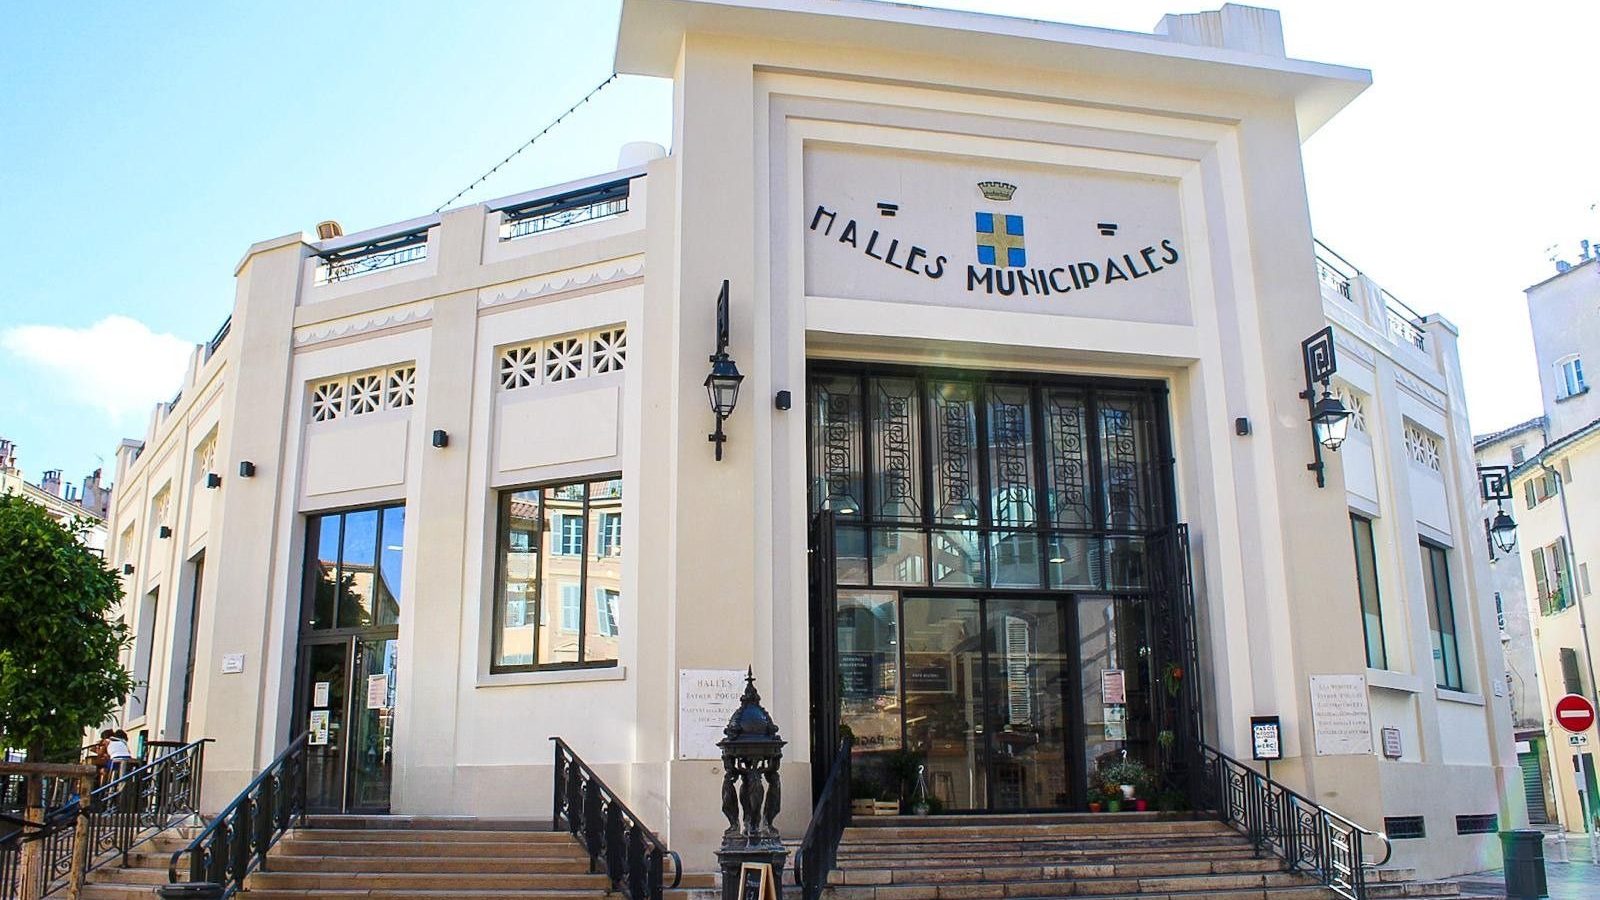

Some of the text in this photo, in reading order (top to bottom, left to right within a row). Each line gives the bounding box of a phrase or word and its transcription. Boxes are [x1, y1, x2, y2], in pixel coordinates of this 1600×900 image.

[810, 206, 1179, 297] HALLES MUNICIPALES
[697, 679, 733, 688] HALLES
